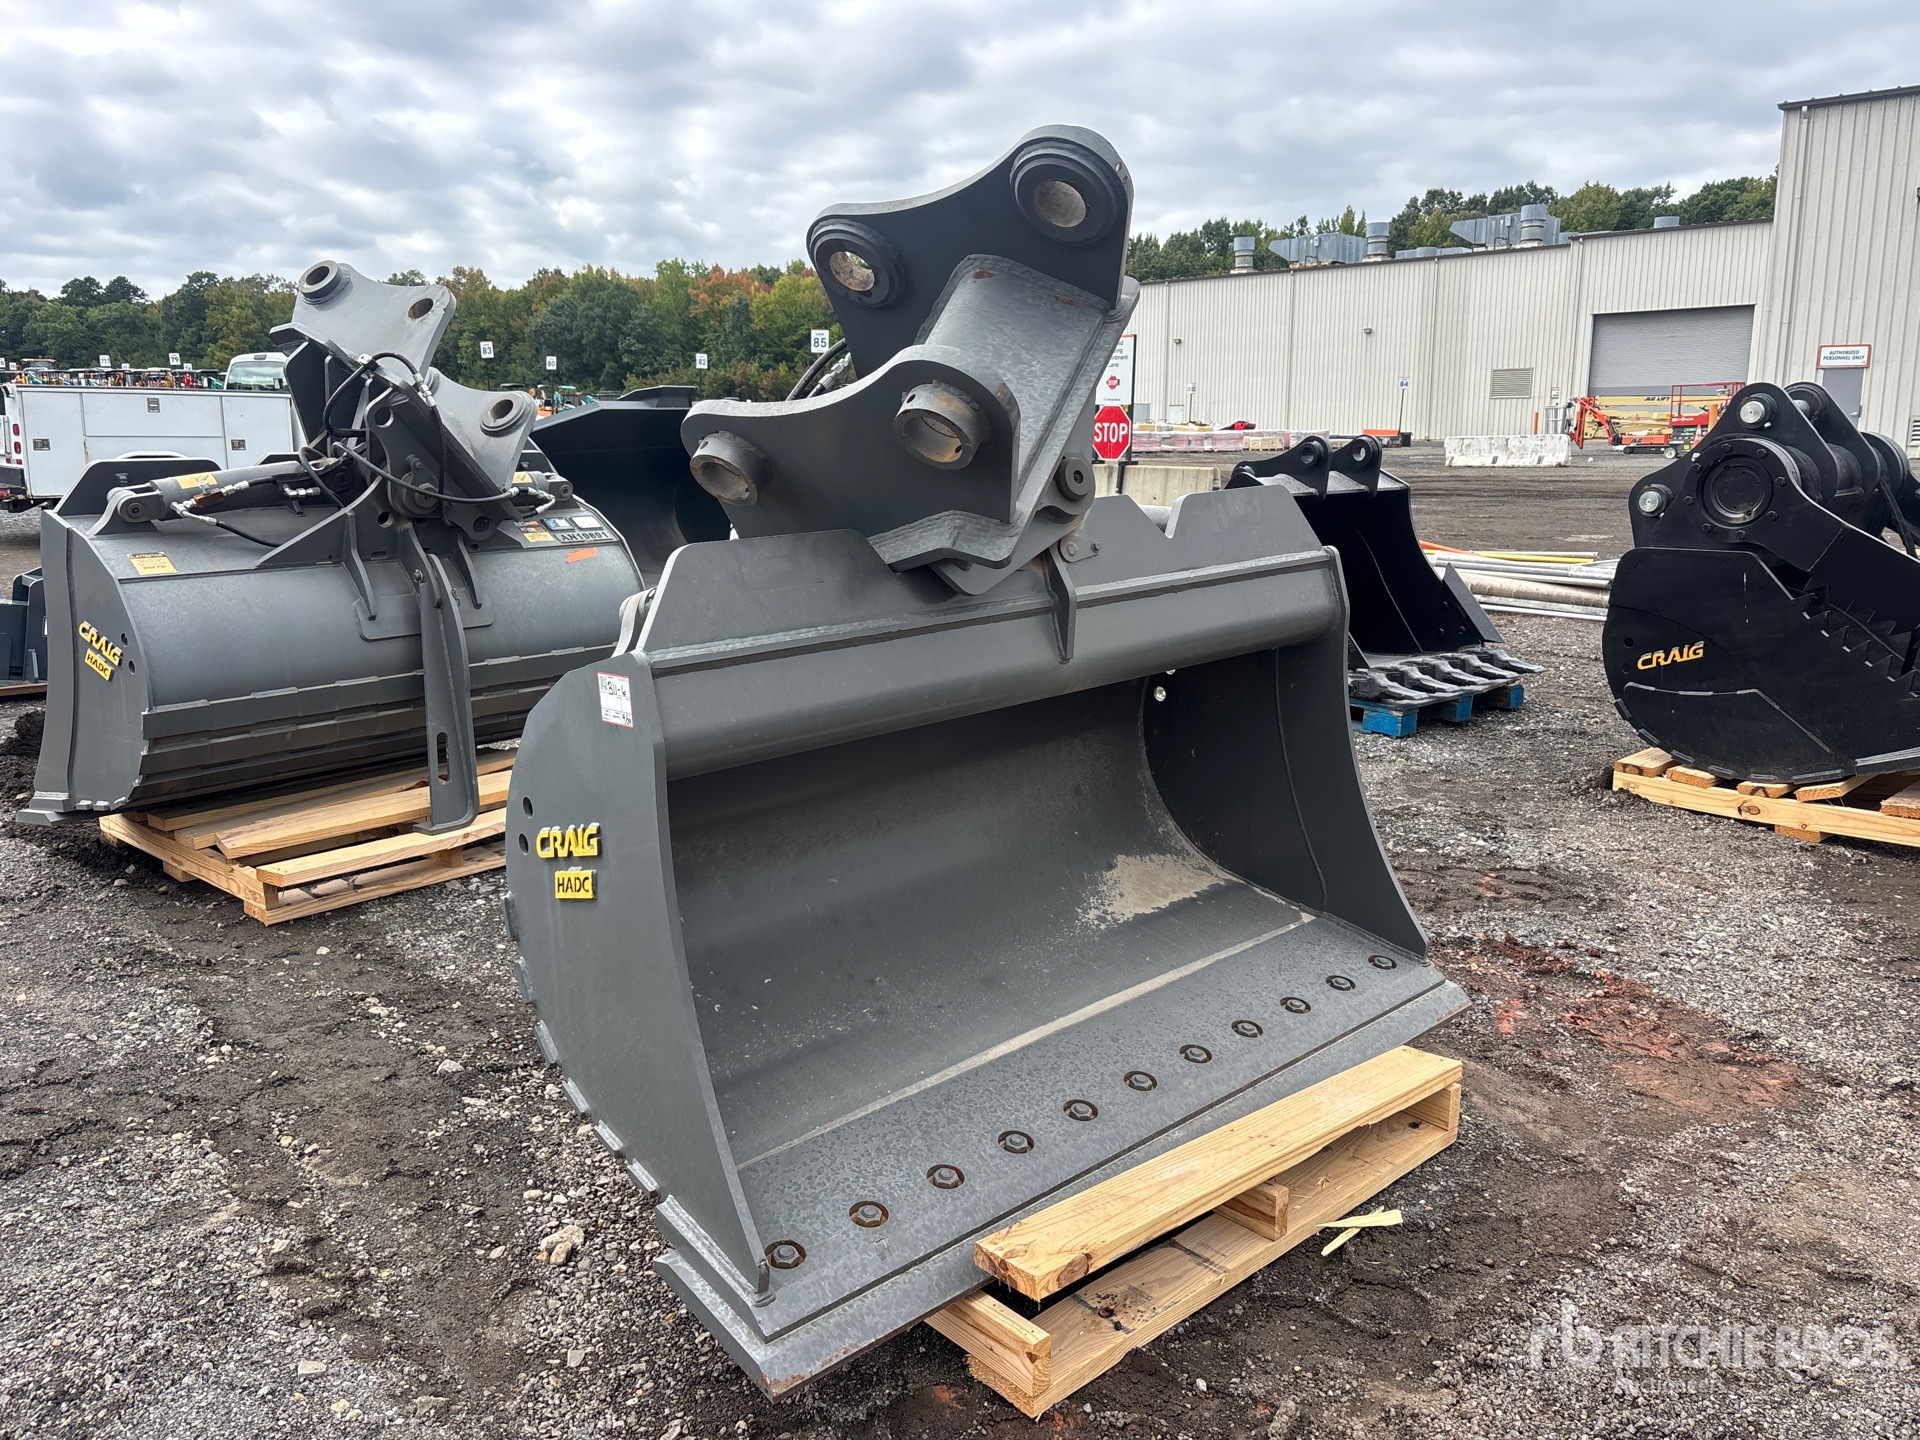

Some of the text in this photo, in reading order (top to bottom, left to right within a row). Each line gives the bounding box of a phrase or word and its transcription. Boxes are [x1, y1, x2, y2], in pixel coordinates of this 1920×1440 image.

[482, 346, 492, 355] 83
[813, 337, 827, 348] 85
[1094, 422, 1128, 443] STOP
[79, 620, 123, 667] CRAIG
[86, 653, 110, 677] HADC
[1637, 641, 1705, 670] CRAIG
[536, 823, 601, 859] CRAIG
[557, 876, 590, 893] HADC
